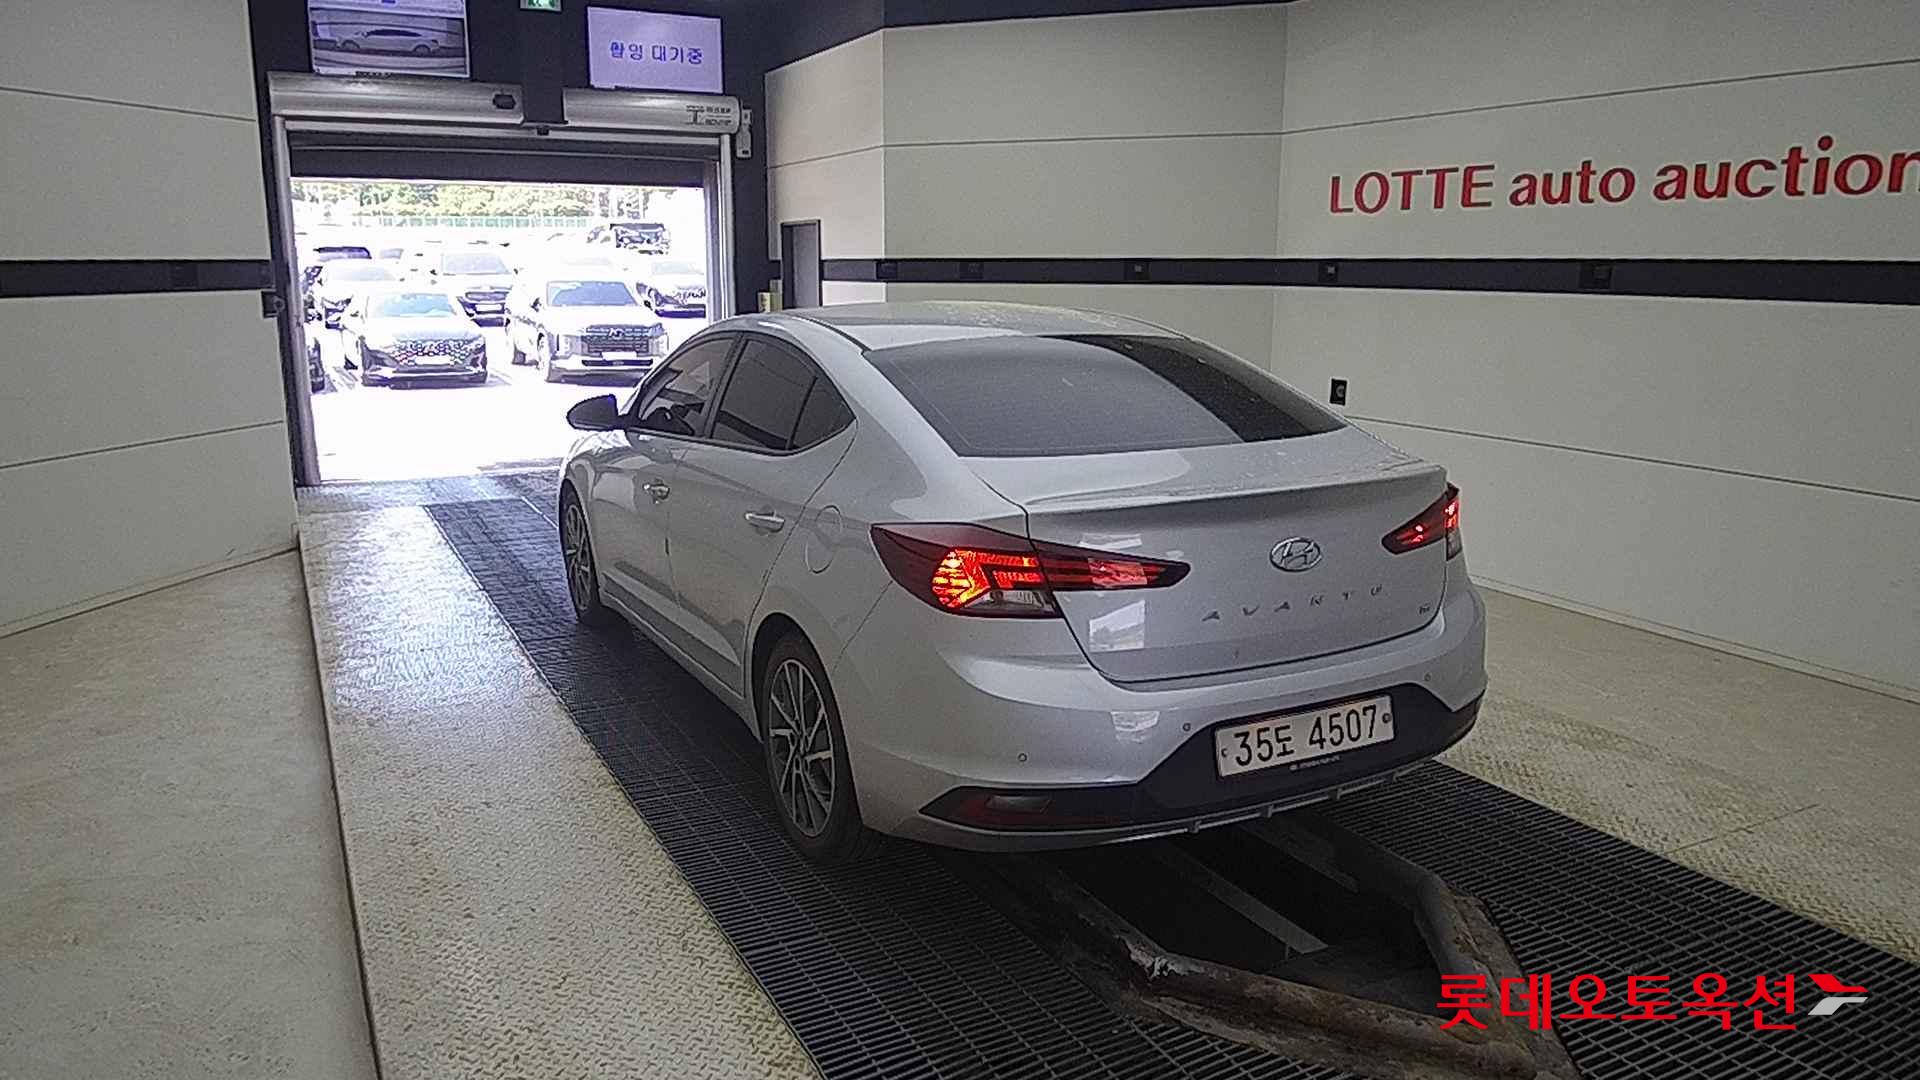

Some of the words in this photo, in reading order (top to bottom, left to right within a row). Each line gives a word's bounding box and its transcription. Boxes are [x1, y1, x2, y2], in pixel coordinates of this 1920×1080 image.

[651, 44, 703, 65] 대기중
[1330, 164, 1495, 214] LOTTE
[1509, 160, 1636, 206] auto
[1233, 725, 1295, 767] 35도
[1309, 704, 1377, 749] 4507
